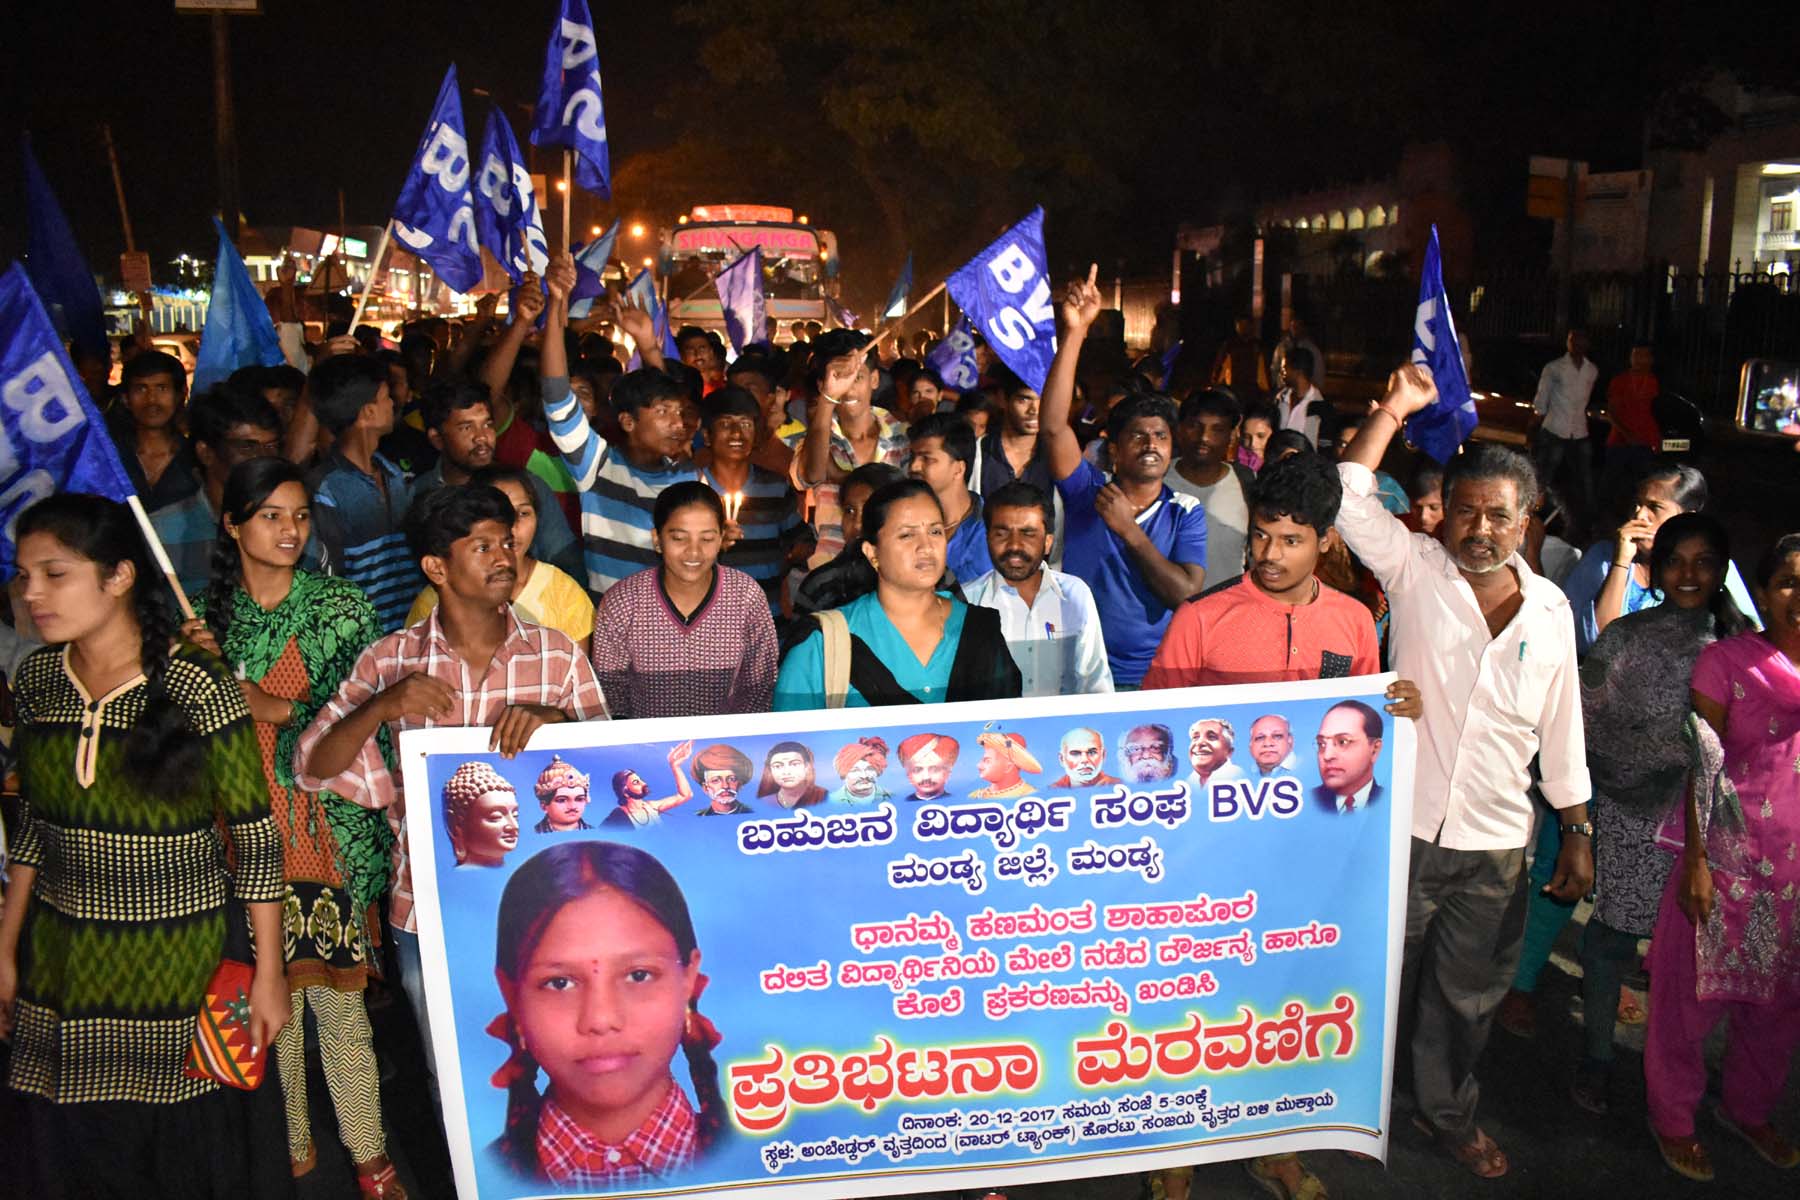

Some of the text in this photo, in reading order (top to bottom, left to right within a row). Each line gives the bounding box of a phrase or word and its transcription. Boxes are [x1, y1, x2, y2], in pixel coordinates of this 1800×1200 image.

[741, 780, 1299, 850] ಬಹುಜನ ವಿದ್ಯಾರ್ಥಿ ಸಂಘ BVS
[892, 842, 1160, 891] ಮಂಡ್ಯ ಜಿಲ್ಲೆ, ಮಂಡ್ಯ
[970, 904, 1092, 936] ಹಣಮಂತ
[1107, 894, 1254, 927] ಶಾಹಾಪೂರ
[764, 923, 1337, 990] ದಲಿತ ವಿದ್ಯಾರ್ಥಿನಿಯ ಮೇಲೆ ನಡೆದ ದೌರ್ಜನ್ಯ ಹಾಗೂ
[897, 972, 1216, 1016] ಕೊಲೆ ಪ್ರಕರಣವನ್ನು ಖಂಡಿಸಿ
[731, 996, 1355, 1130] ಪ್ರತಿಭಟನಾ ಮೆರವಣಿಗೆ
[802, 1138, 876, 1160] ಅಂಬೇಡ್ಕರ್
[883, 1133, 947, 1157] ವೃತ್ತದಿಂದ
[1082, 1120, 1135, 1137] ಹೊರಟು
[1142, 1111, 1195, 1129] ಸಂಜಯ
[1202, 1105, 1240, 1128] ವೃತ್ತದ
[1246, 1104, 1269, 1116] ಬಳಿ
[1276, 1092, 1334, 1113] ಮುಕ್ತಾಯ
[903, 1114, 962, 1130] ದಿನಾಂಕ:
[969, 1109, 1055, 1126] 20-12-2017
[1063, 1102, 1111, 1119] ಸಮಯ
[1118, 1095, 1152, 1113] ಸಂಜೆ
